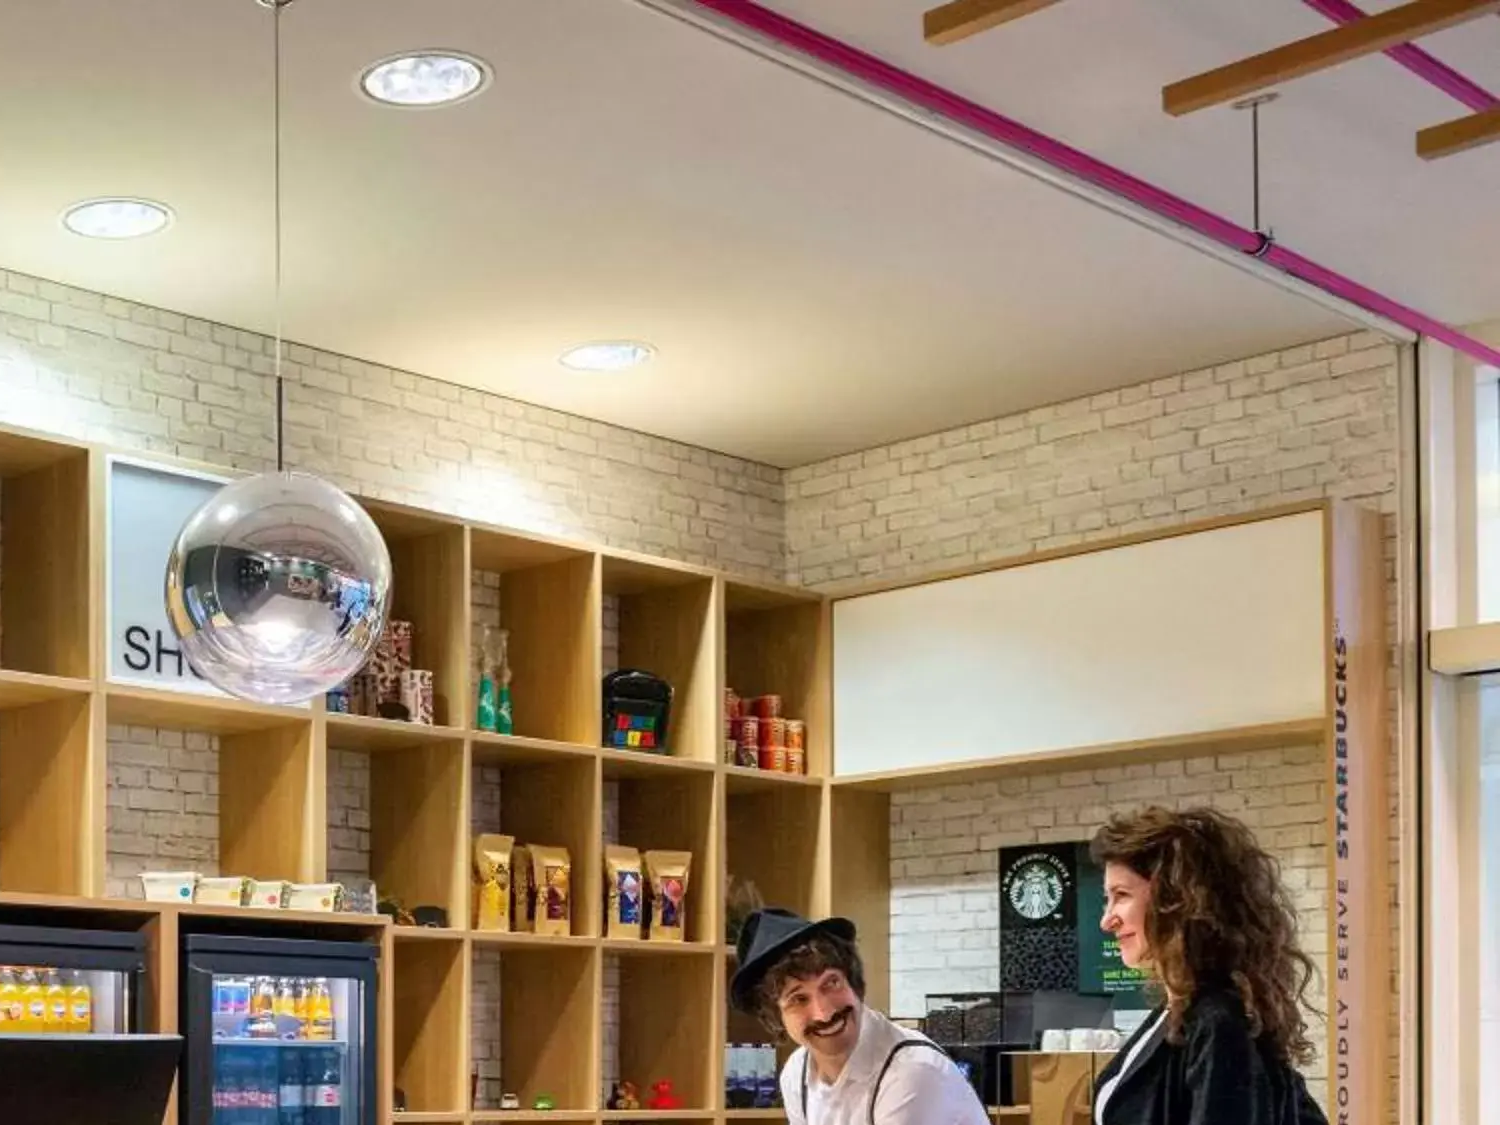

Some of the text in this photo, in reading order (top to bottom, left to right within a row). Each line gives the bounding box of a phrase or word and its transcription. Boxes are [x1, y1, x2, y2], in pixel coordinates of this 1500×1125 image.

[124, 625, 205, 680] SH
[1335, 635, 1349, 860] STARBUCKS
[1337, 879, 1349, 980] SERVE
